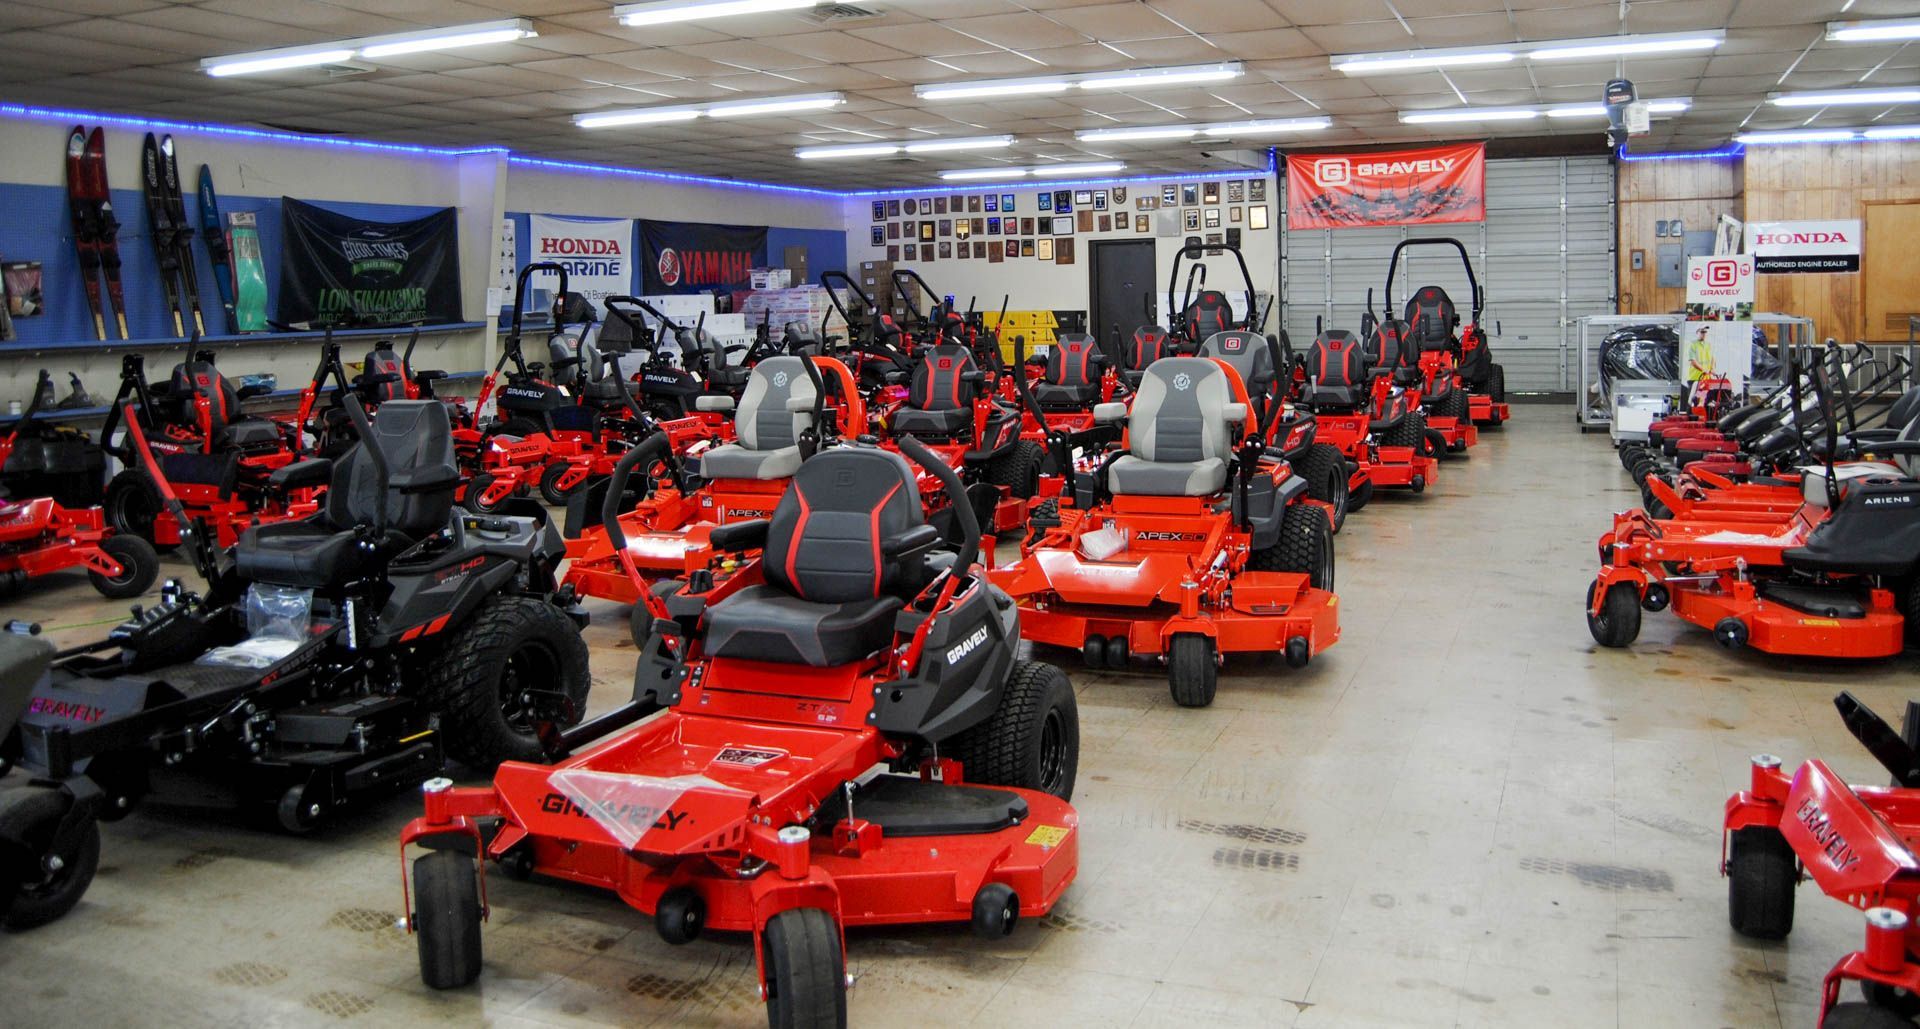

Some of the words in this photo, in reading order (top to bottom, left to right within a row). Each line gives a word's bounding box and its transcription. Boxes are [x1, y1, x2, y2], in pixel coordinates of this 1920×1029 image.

[1357, 158, 1455, 177] GRAVELY
[541, 237, 621, 255] HONDA
[1757, 232, 1848, 246] HONDA
[681, 251, 751, 285] YAMAHA
[1756, 260, 1797, 269] AUTHORIZED
[1797, 260, 1822, 268] ENGINE
[1822, 260, 1848, 268] DEALER
[1700, 288, 1741, 297] GRAVELY
[1864, 495, 1911, 505] ARIENS
[727, 508, 775, 517] APEX
[946, 624, 988, 665] GRAVELY
[542, 793, 688, 831] GRAVELY
[1796, 798, 1860, 873] GRAVELY
